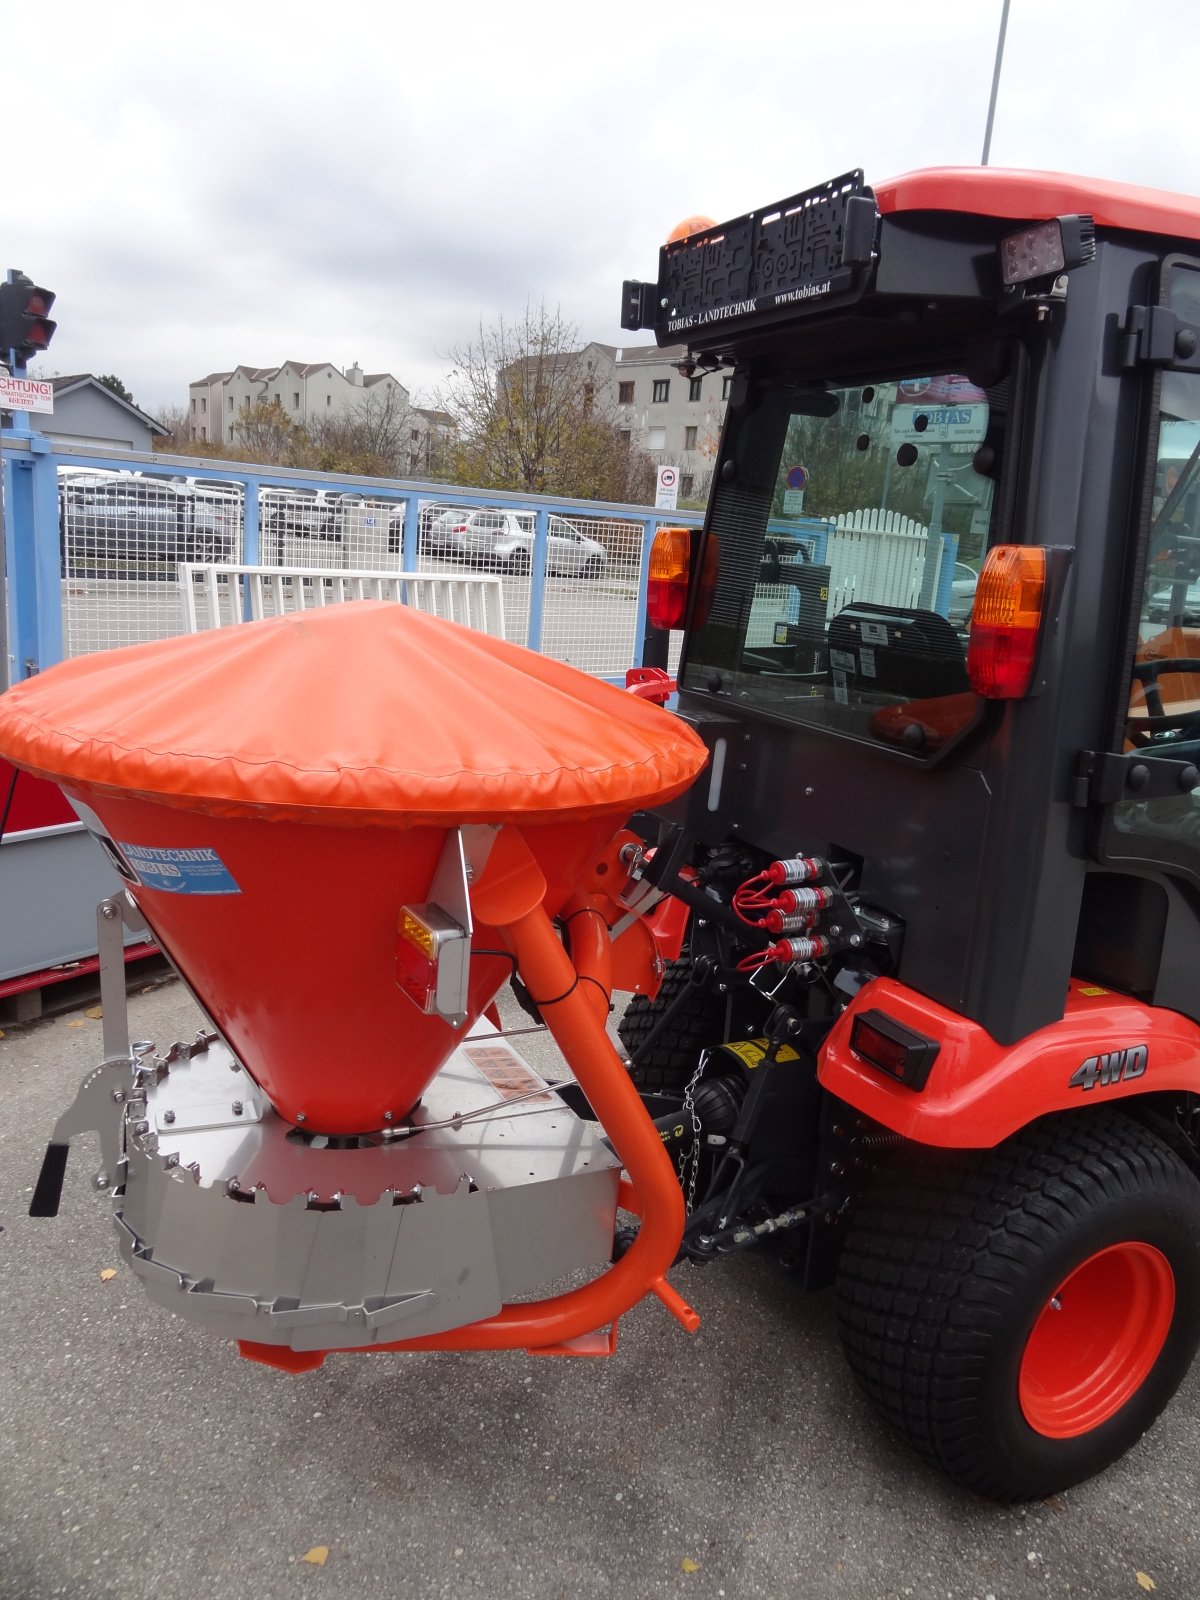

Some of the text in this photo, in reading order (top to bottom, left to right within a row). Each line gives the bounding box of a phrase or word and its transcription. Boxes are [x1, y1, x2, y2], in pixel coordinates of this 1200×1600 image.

[668, 315, 693, 332] TOBIAS
[698, 299, 757, 324] LANDTECHNIK
[775, 280, 831, 305] www.tobias.at
[120, 842, 218, 862] LANDTECHNIK
[130, 860, 179, 876] TOBIAS
[1068, 1044, 1149, 1092] 4WD
